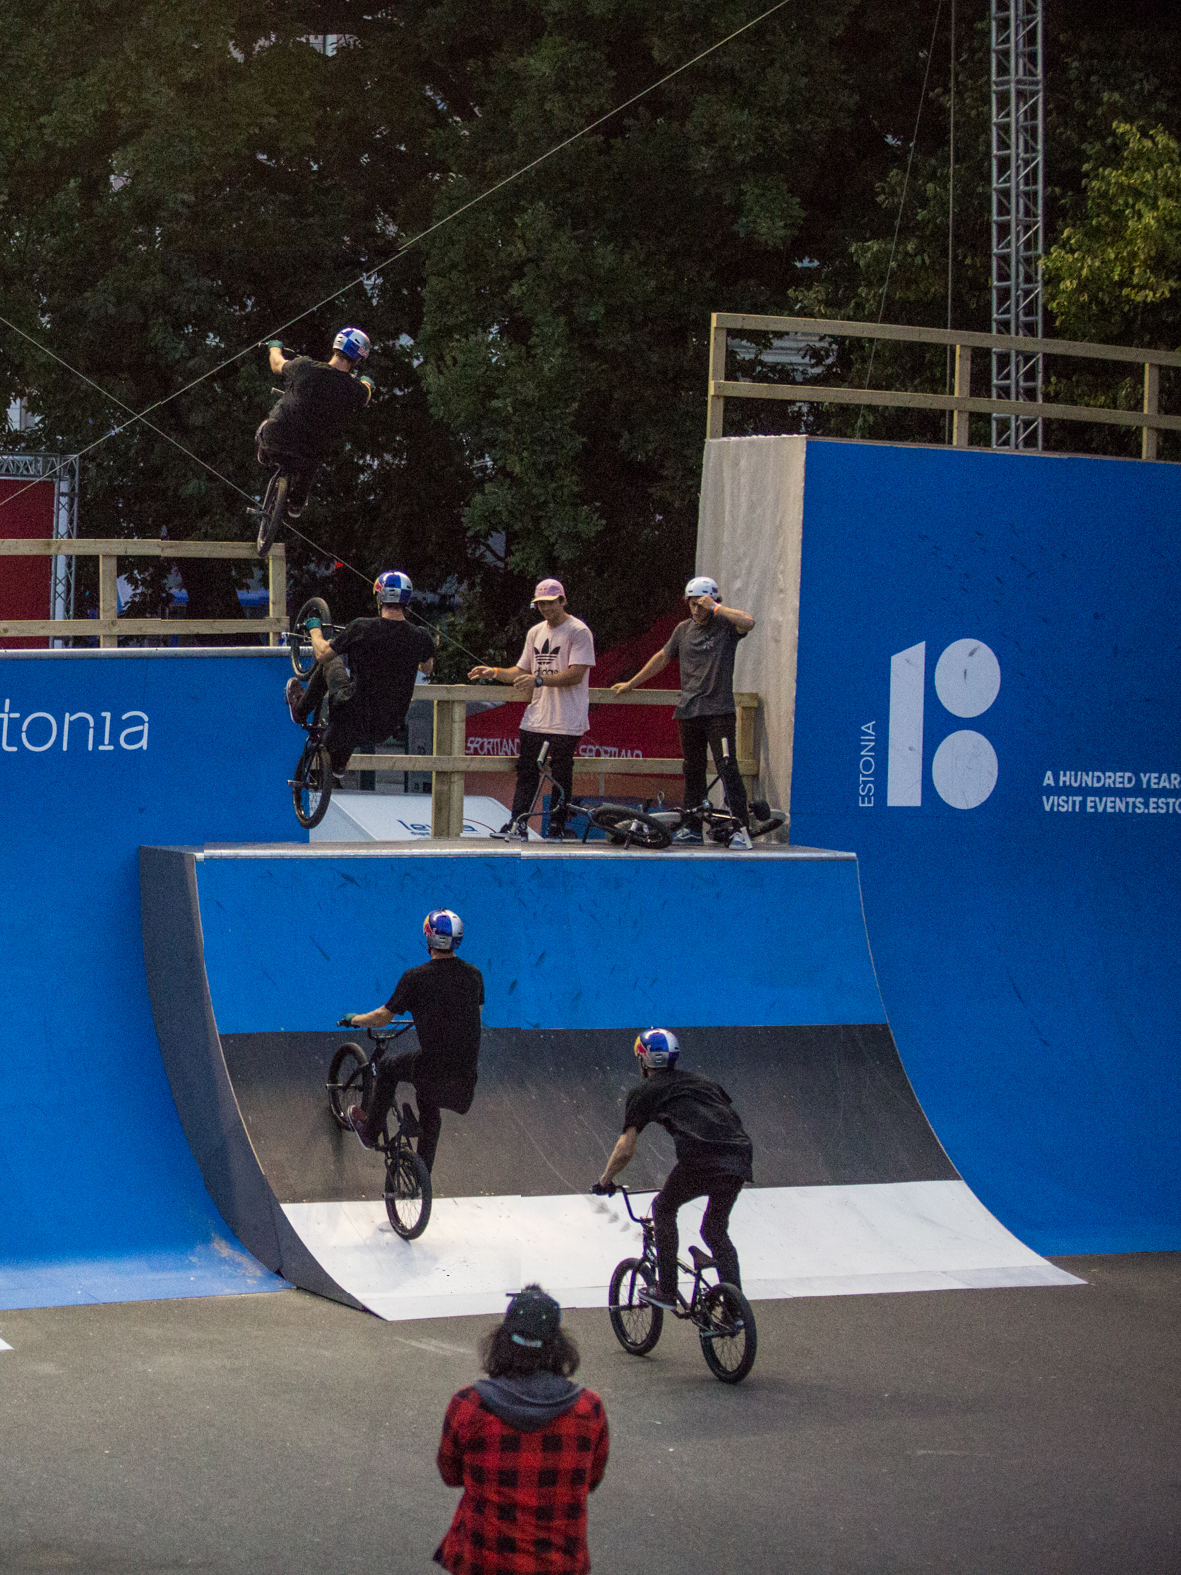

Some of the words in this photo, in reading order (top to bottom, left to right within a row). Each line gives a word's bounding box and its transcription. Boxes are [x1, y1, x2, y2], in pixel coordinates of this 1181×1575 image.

[859, 720, 876, 807] ESTONIA
[1042, 770, 1055, 787] A
[1059, 770, 1136, 788] HUNDRED
[1139, 772, 1181, 789] YEAR
[1042, 795, 1083, 812] VISIT
